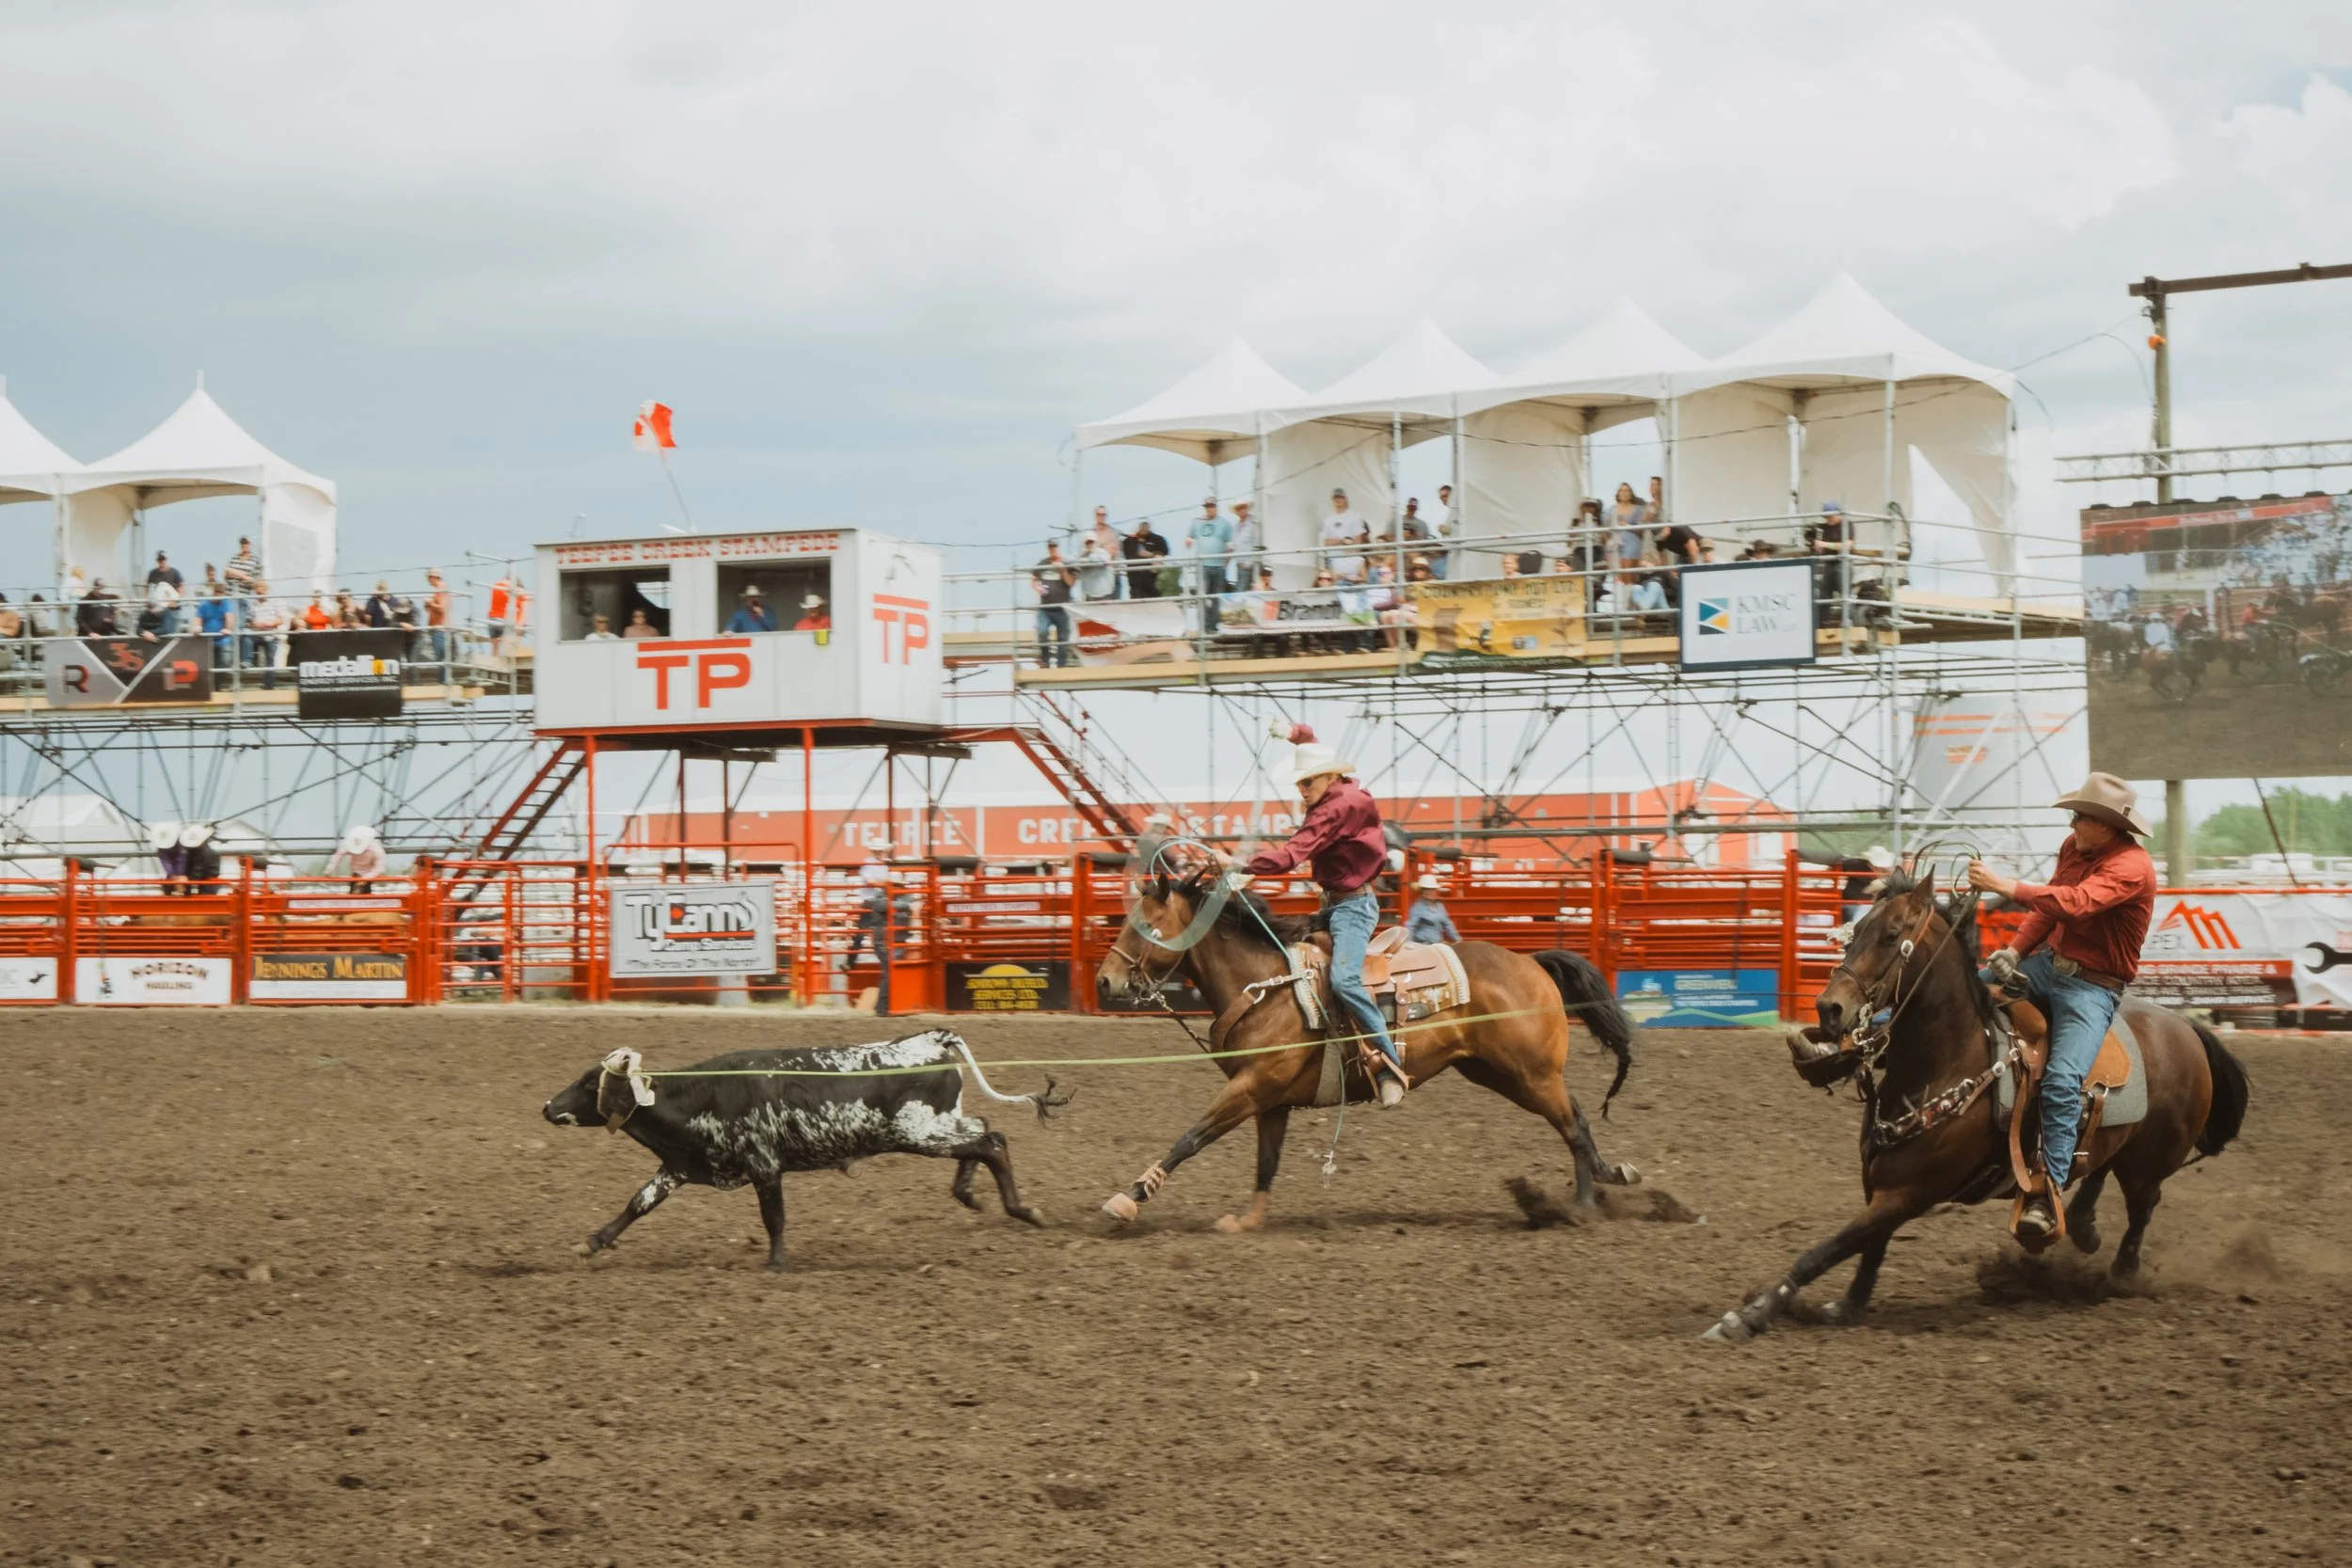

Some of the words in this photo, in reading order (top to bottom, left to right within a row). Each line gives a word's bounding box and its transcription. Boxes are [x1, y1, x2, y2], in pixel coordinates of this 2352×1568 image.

[555, 544, 633, 564] TEEPEE
[643, 540, 711, 560] CREEK
[720, 531, 839, 556] STAMPEDE
[1277, 599, 1342, 621] Brandt
[1736, 594, 1798, 614] KMSC
[1735, 614, 1781, 634] LAW
[872, 607, 930, 666] TP
[298, 654, 400, 678] medallion
[636, 652, 752, 710] TP
[129, 961, 209, 979] HORIZON
[145, 981, 193, 990] HAULING
